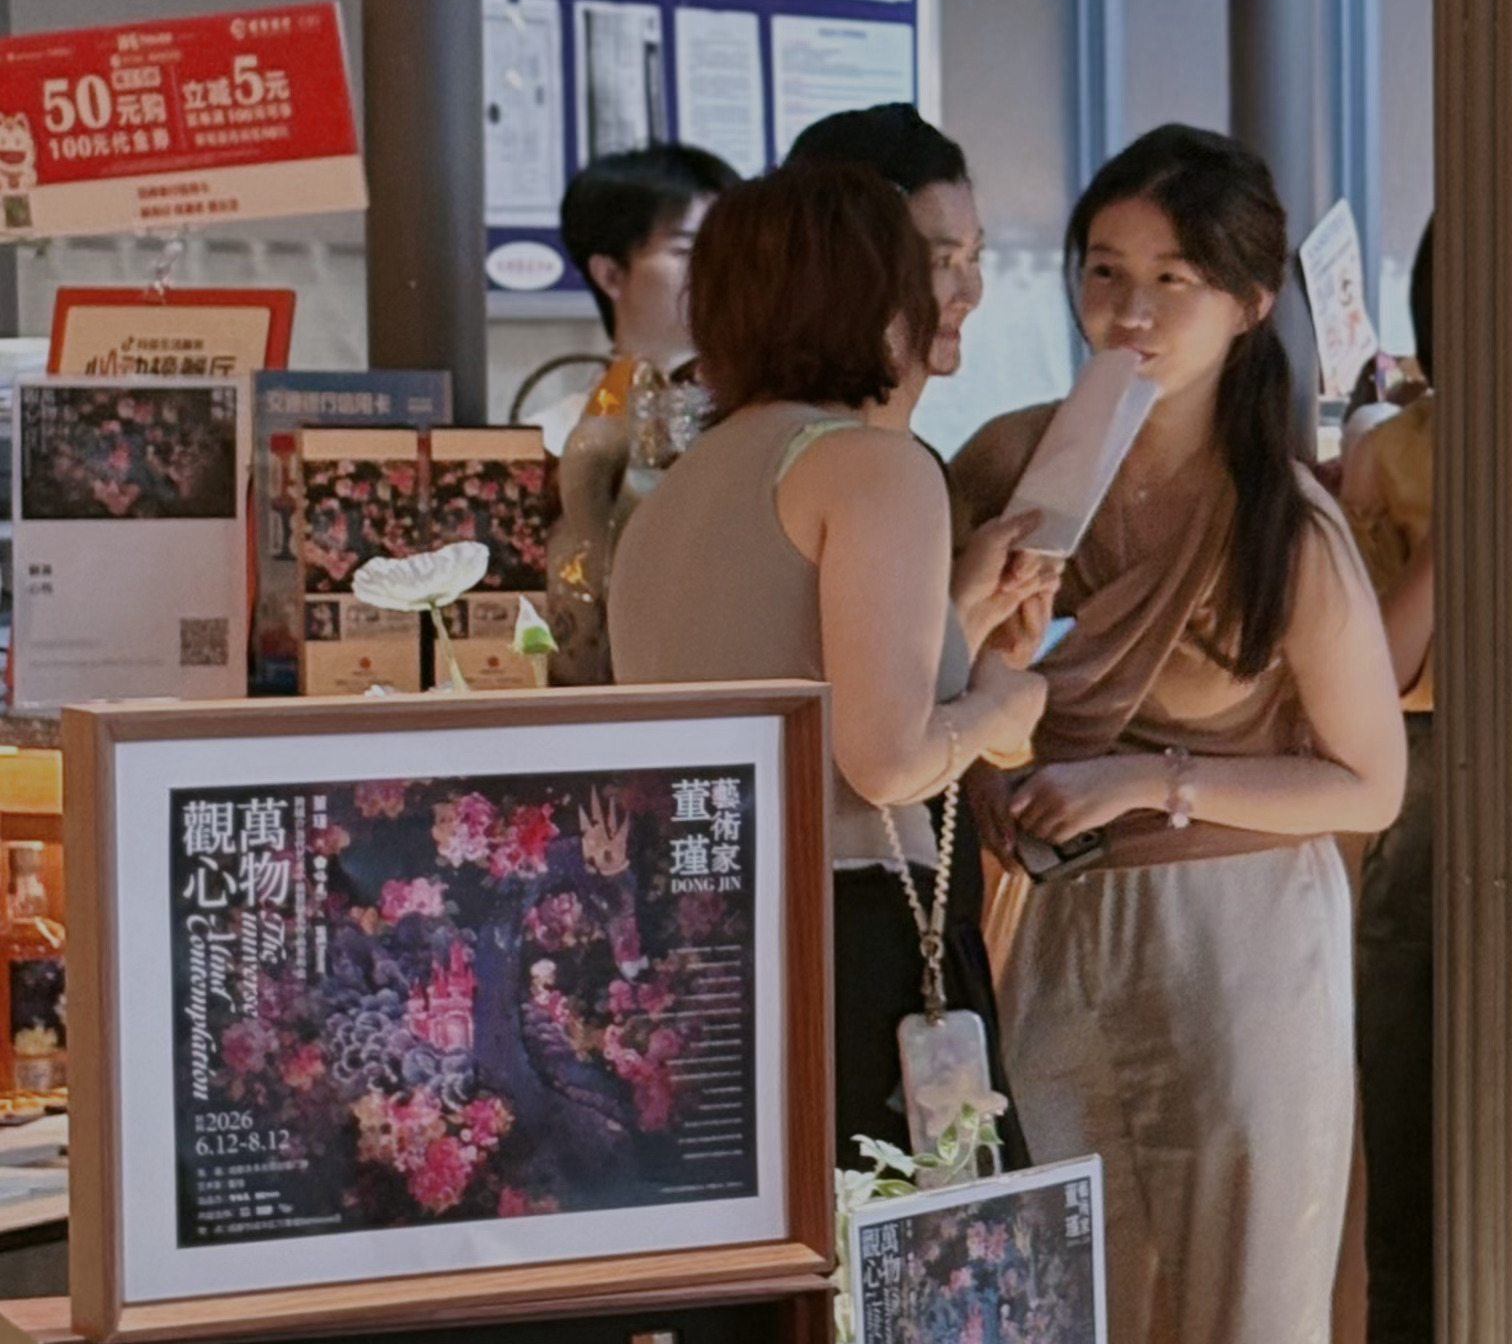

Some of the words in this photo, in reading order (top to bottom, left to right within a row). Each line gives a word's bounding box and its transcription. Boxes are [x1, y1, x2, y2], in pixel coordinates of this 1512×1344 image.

[49, 127, 169, 160] 100元代金券
[182, 800, 238, 908] 觀心
[238, 797, 290, 907] 萬物
[669, 778, 711, 875] 董瑾
[710, 777, 742, 874] 藝術家
[671, 877, 715, 893] DONG
[718, 876, 742, 892] JIN
[184, 914, 217, 1101] Contemplation
[195, 1129, 290, 1156] 6.12-8.12
[206, 1110, 253, 1132] 2026
